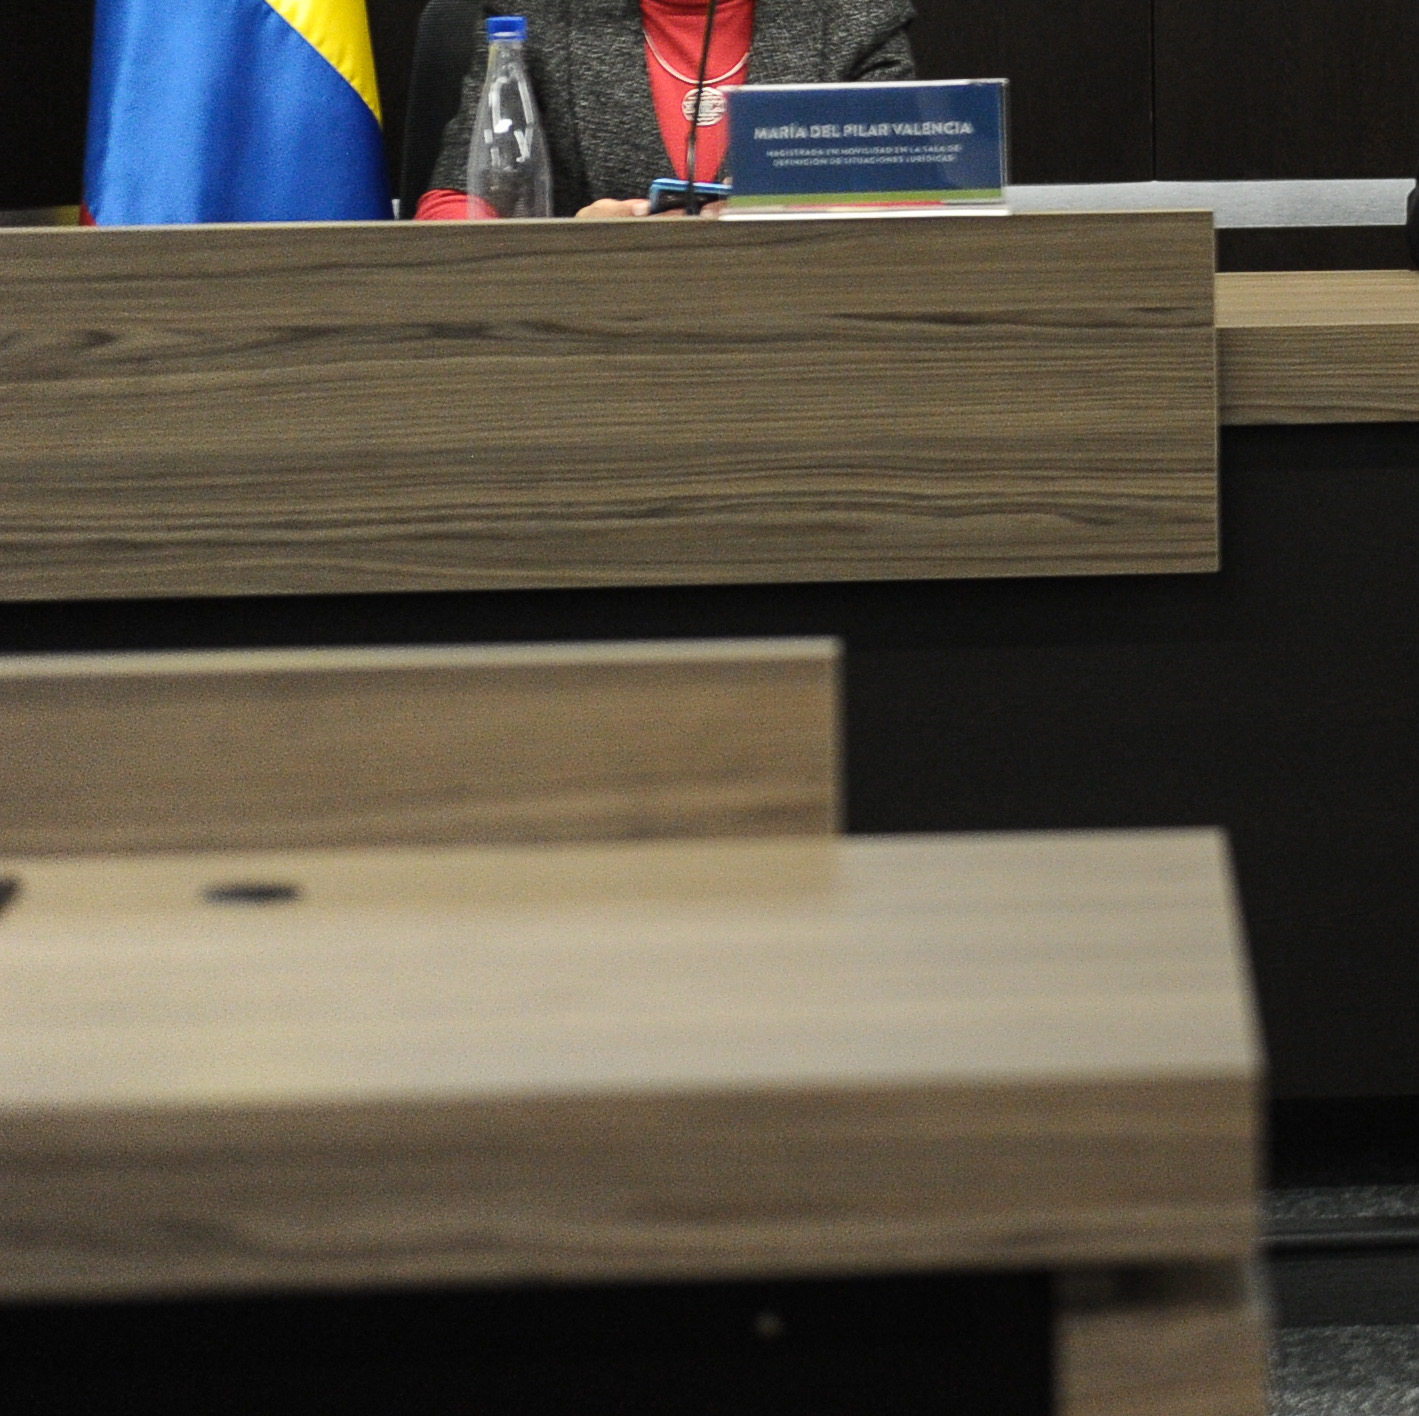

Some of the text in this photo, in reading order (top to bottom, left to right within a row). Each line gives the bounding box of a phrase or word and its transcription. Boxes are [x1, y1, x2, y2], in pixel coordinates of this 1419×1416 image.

[754, 121, 974, 139] MARÍA DEL PILAR VALENCIA
